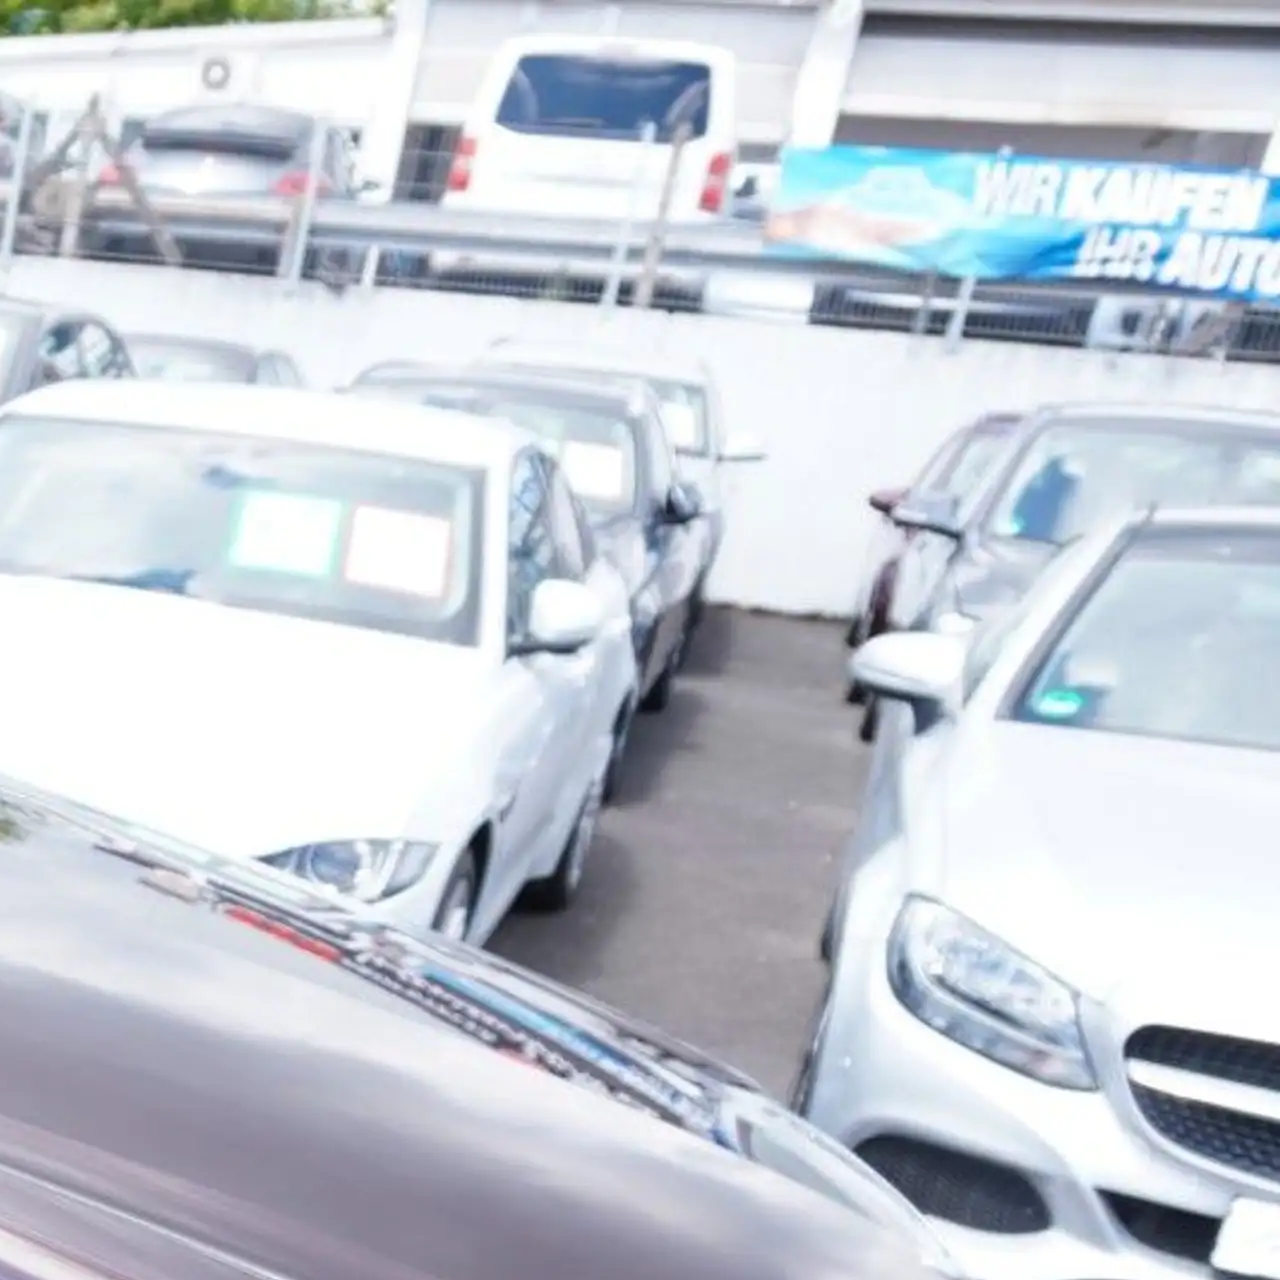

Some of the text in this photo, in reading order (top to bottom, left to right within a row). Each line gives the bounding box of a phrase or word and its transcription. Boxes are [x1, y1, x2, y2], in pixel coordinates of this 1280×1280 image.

[974, 160, 1269, 231] WIR KAUFEN
[1074, 224, 1162, 280] IHR
